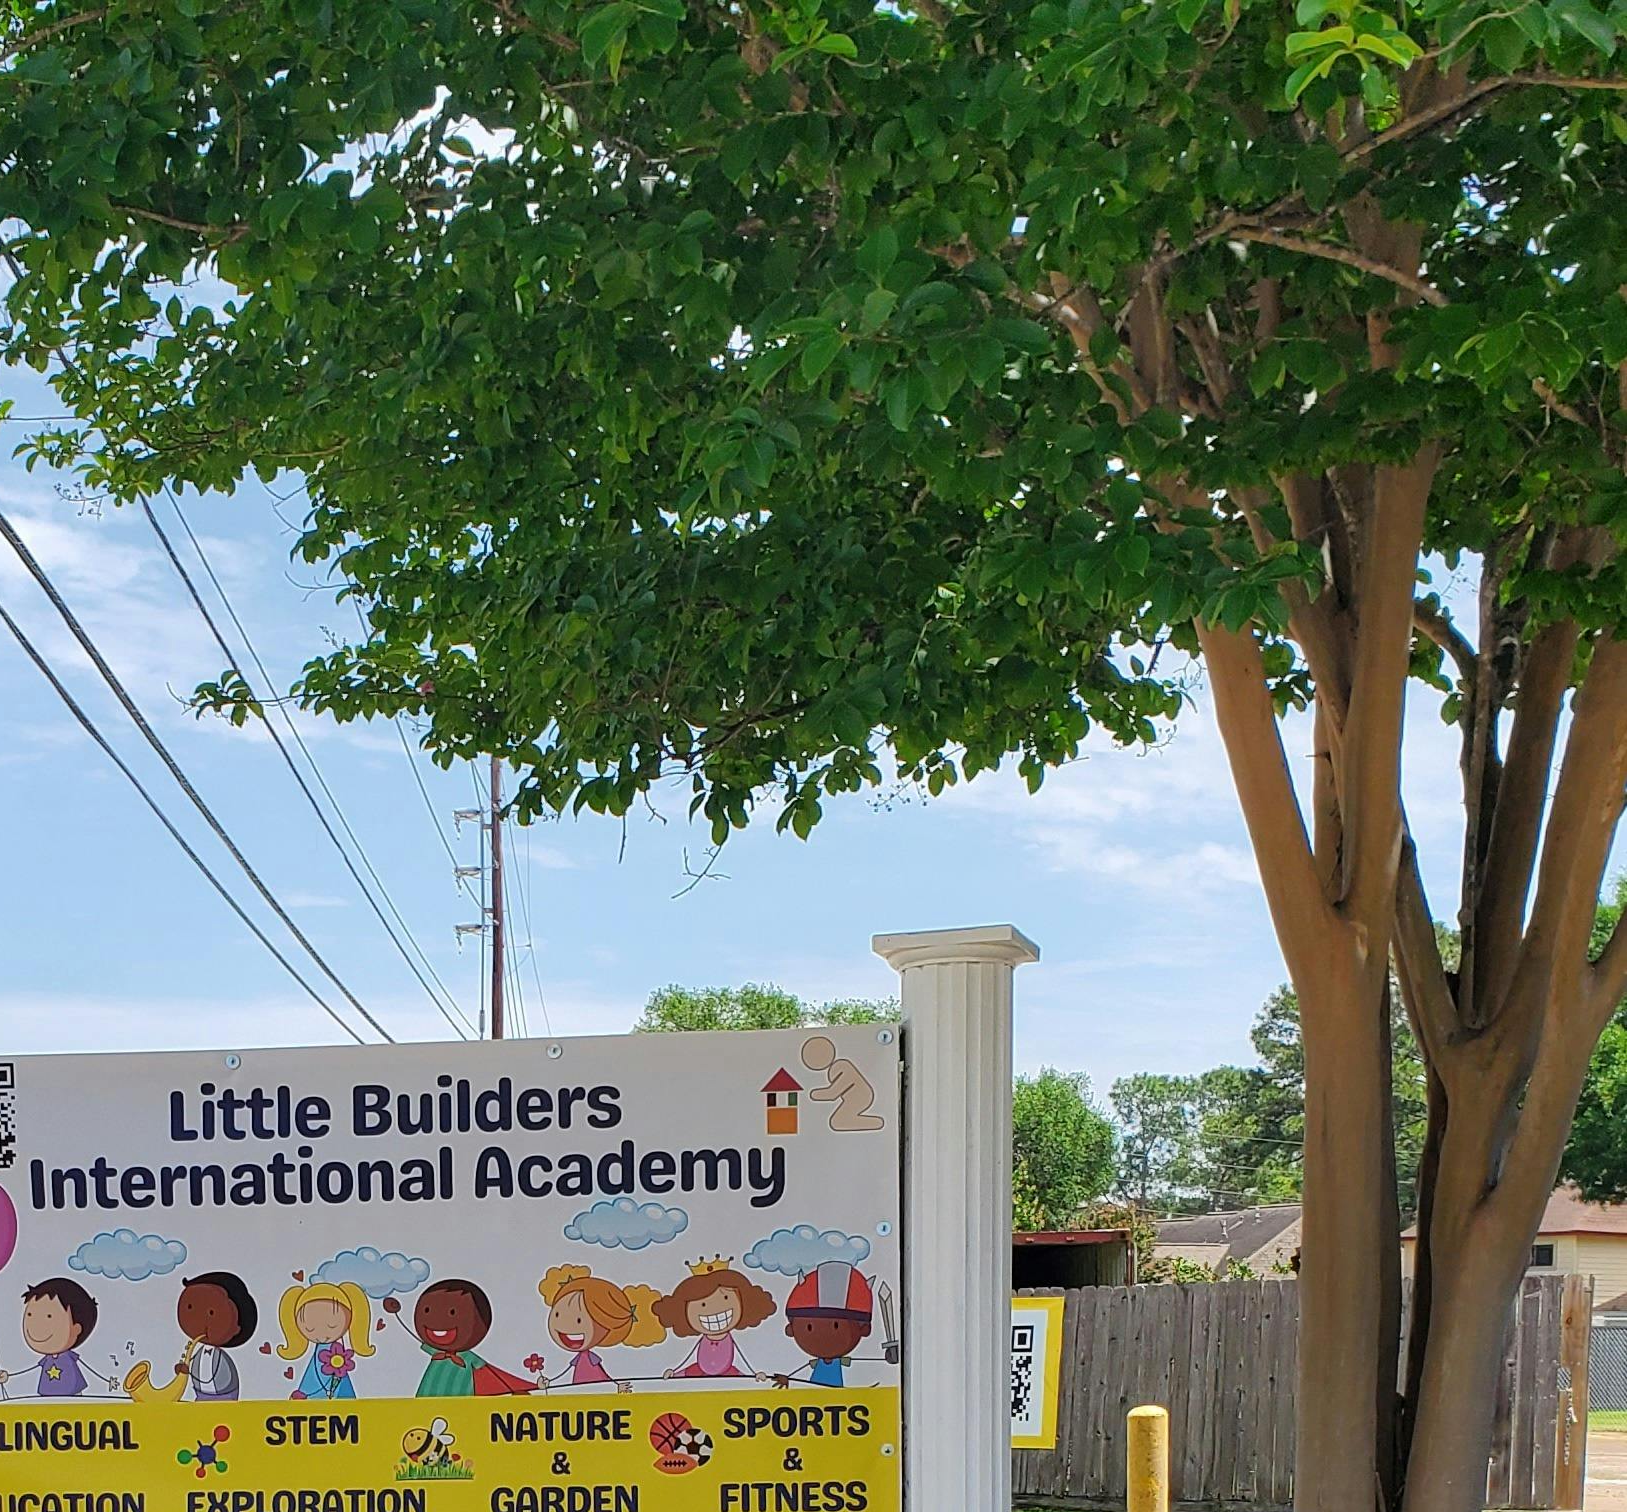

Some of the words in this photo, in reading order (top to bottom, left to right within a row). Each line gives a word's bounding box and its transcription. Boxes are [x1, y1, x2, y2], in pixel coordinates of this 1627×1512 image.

[170, 1083, 331, 1141] Little
[352, 1075, 622, 1137] Builders
[30, 1146, 454, 1209] International
[475, 1140, 786, 1207] Academy
[265, 1415, 359, 1446] STEM
[491, 1410, 632, 1442] NATURE
[723, 1405, 870, 1438] SPORTS
[551, 1451, 571, 1475] &
[783, 1447, 803, 1471] &
